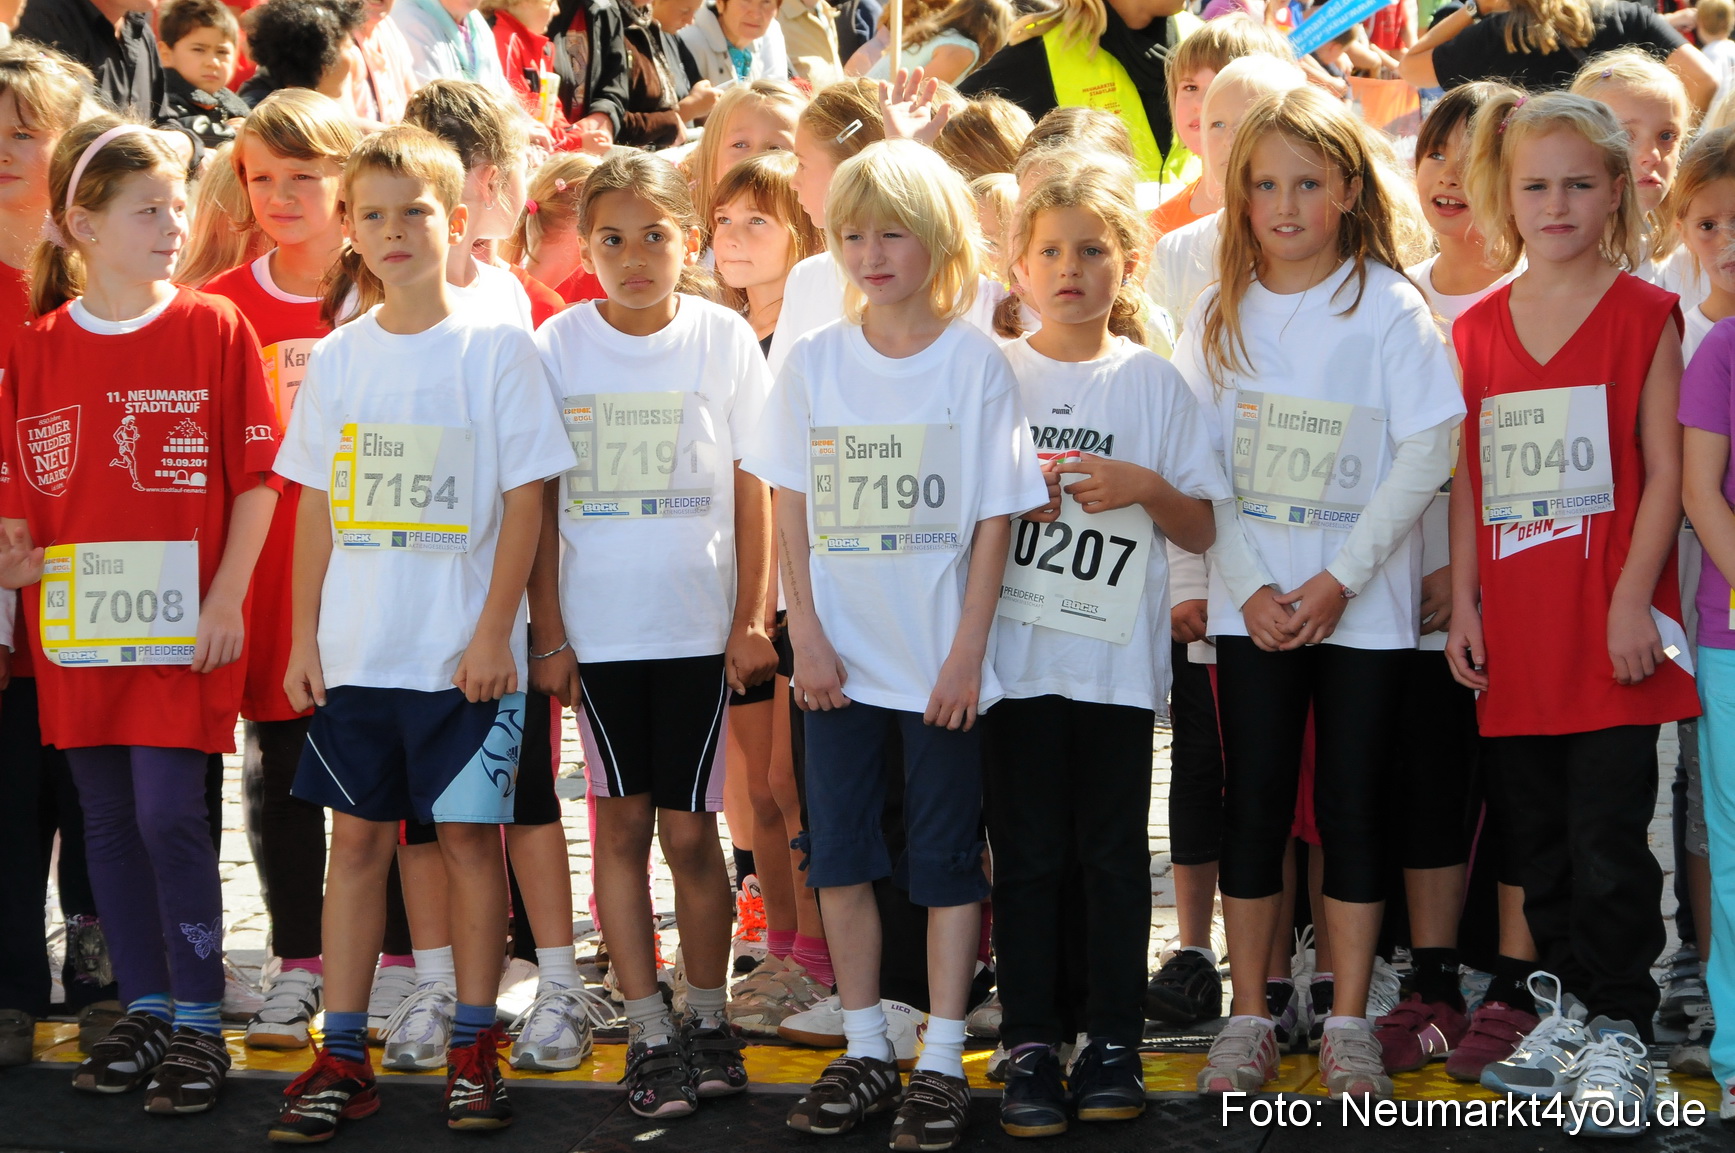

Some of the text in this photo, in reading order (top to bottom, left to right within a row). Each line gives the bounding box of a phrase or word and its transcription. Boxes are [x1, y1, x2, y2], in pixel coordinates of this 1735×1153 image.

[106, 391, 125, 403] 11.
[125, 401, 201, 413] STADTLAUF
[603, 402, 685, 426] Vanessa
[1267, 403, 1343, 437] Luciana
[1498, 404, 1545, 429] Laura
[27, 419, 71, 441] IMMER
[27, 433, 72, 454] WIEDER
[363, 432, 404, 457] Elisa
[845, 434, 902, 459] Sarah
[1235, 437, 1251, 456] K3
[1482, 445, 1491, 463] K3
[33, 447, 70, 473] NEU
[606, 440, 698, 476] 7191
[1266, 443, 1362, 489] 7049
[1501, 436, 1595, 479] 7040
[335, 470, 348, 488] K3
[816, 474, 832, 493] K3
[364, 473, 459, 510] 7154
[659, 496, 711, 508] PFLEIDERER
[848, 473, 946, 510] 7190
[1550, 493, 1611, 509] PFLEIDERER
[408, 531, 467, 544] PFLEIDERER
[898, 532, 958, 544] PFLEIDERER
[1518, 518, 1554, 542] DEHN
[1014, 519, 1138, 587] 0207
[82, 552, 124, 576] Sina
[47, 590, 65, 608] K3
[1003, 586, 1045, 605] PFLEIDERER
[84, 589, 184, 624] 7008
[138, 645, 195, 656] PFLEIDERER
[891, 1004, 911, 1015] LICO
[177, 1057, 198, 1065] Sport
